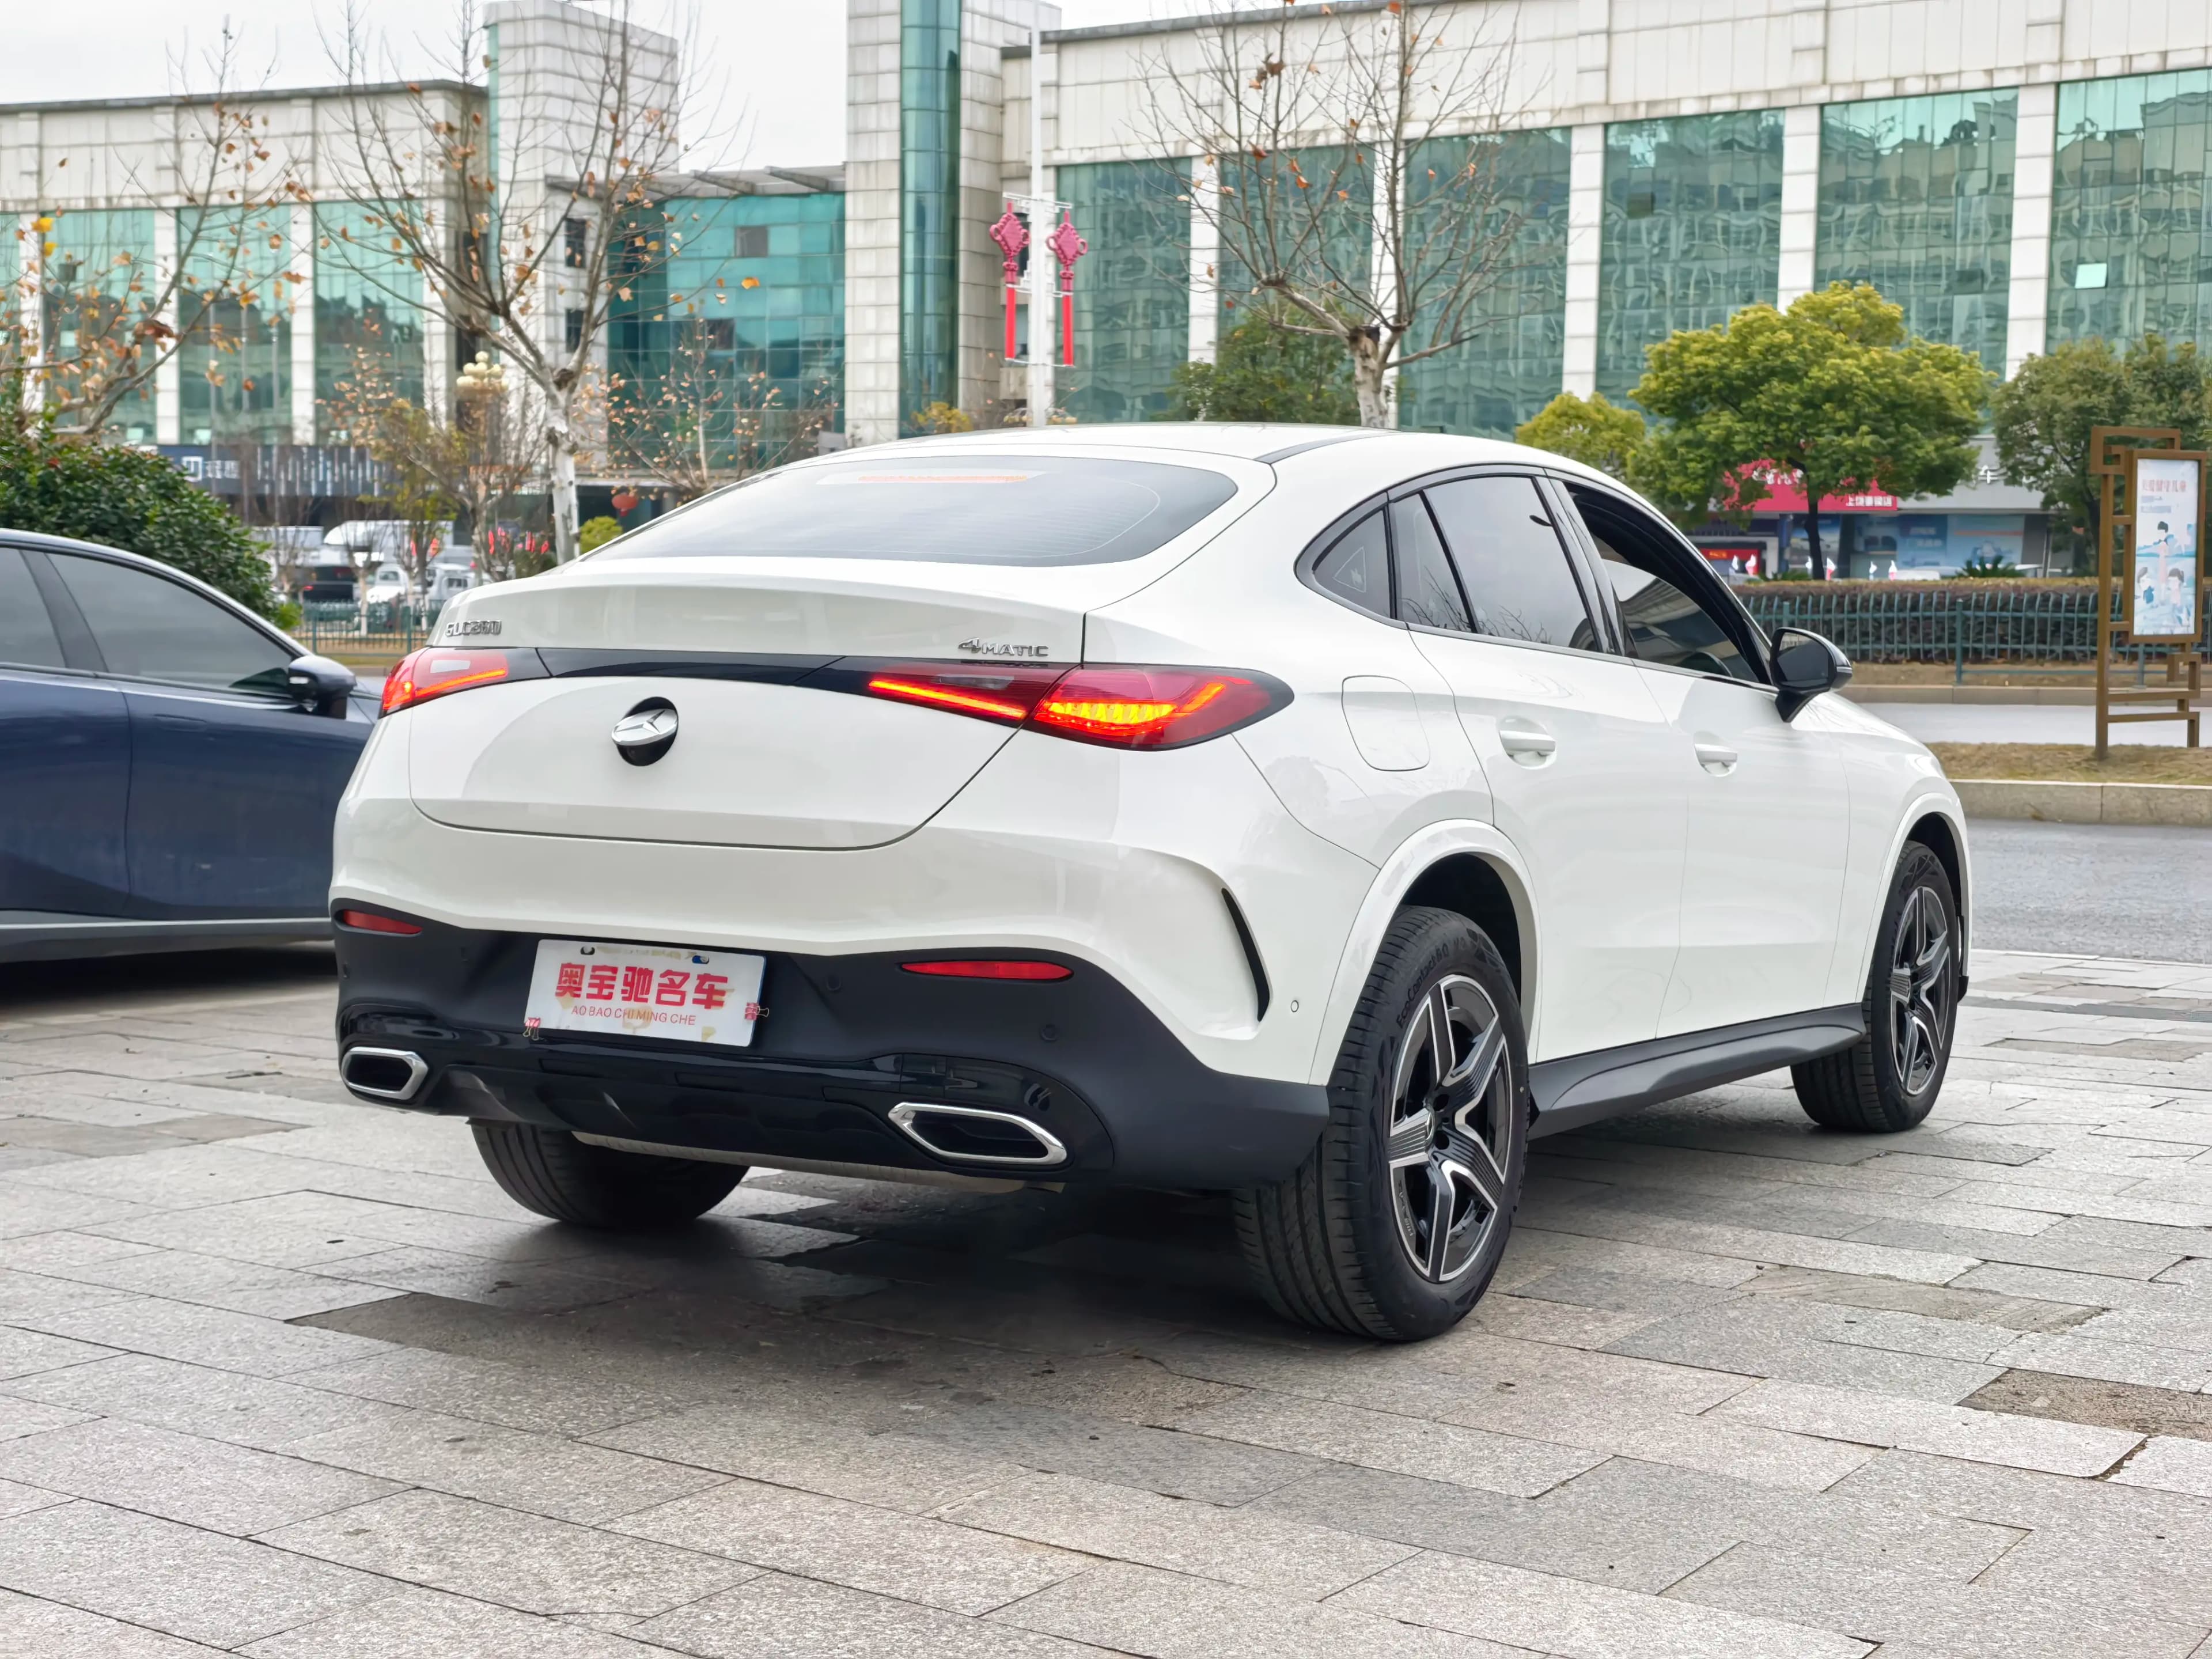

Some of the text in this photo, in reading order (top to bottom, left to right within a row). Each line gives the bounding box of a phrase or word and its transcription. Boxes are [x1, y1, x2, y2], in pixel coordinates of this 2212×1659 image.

[958, 637, 1049, 657] 4MATIC
[555, 962, 729, 1009] 奥宝驰名车
[571, 1005, 586, 1016] AO
[589, 1006, 612, 1018] BAO
[636, 1009, 667, 1023] MING
[670, 1013, 696, 1025] CHE
